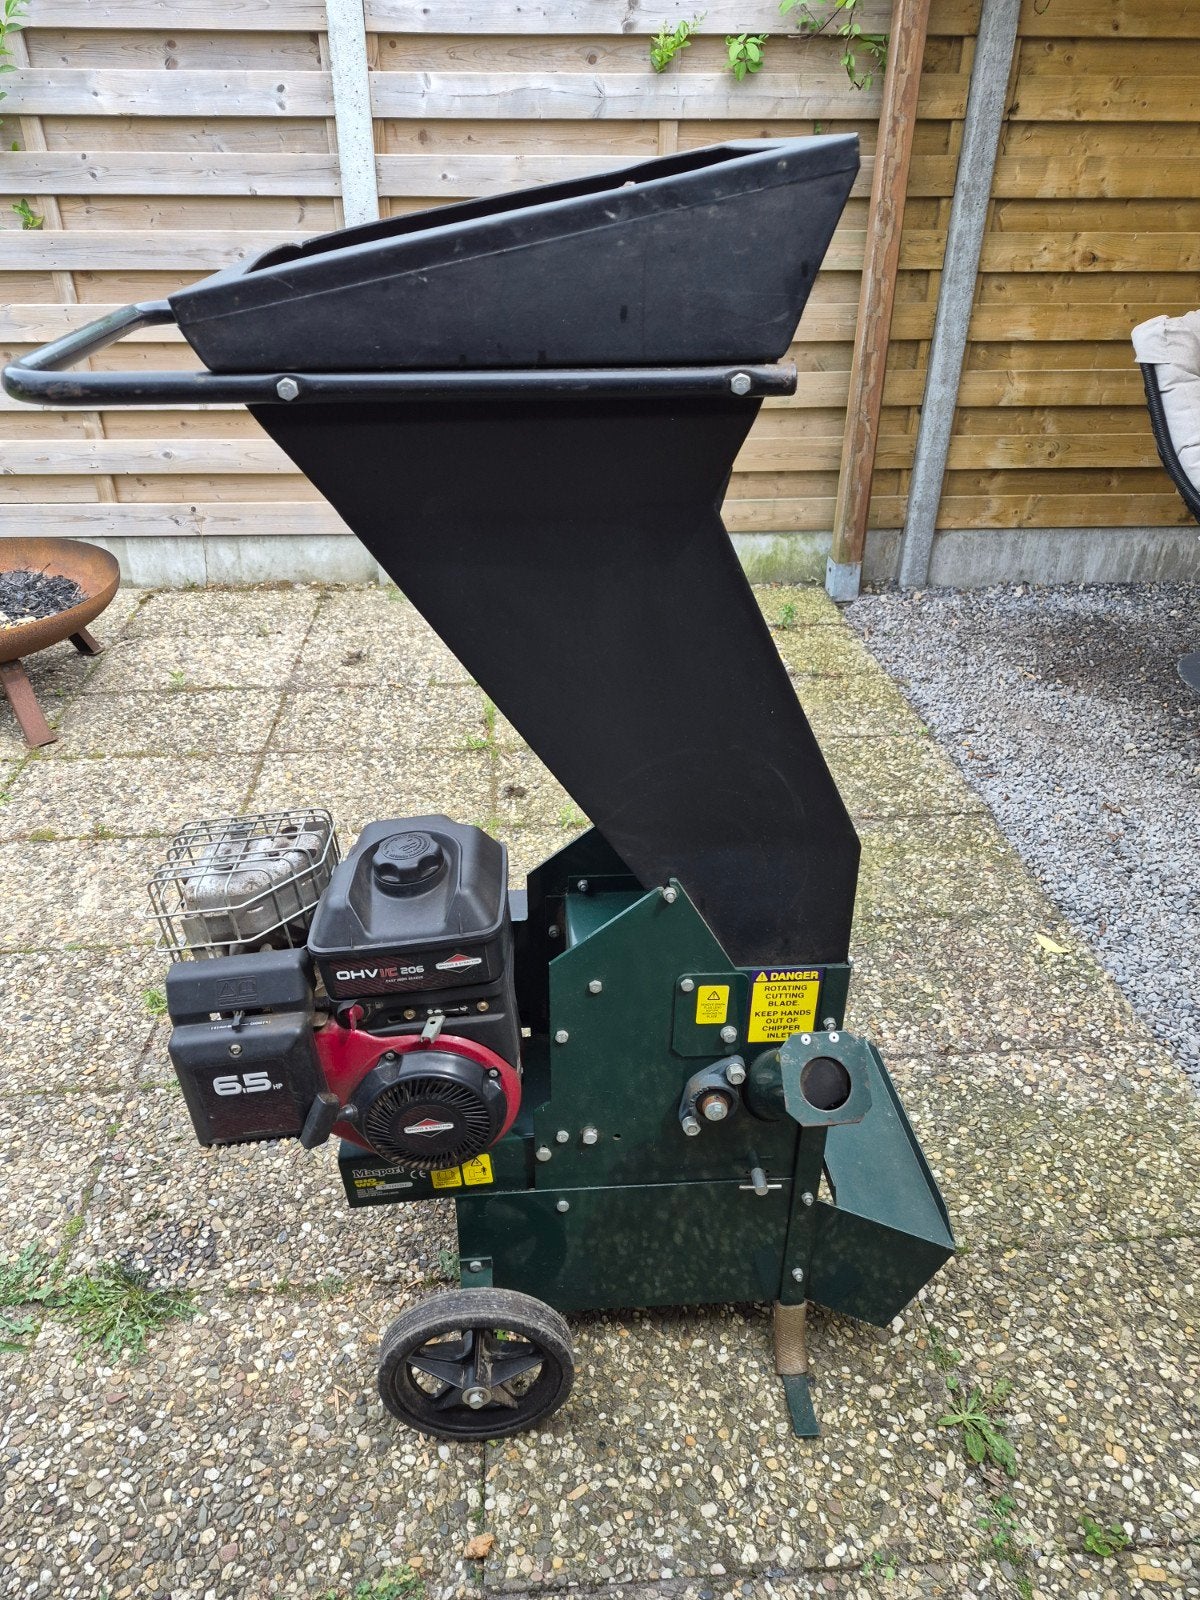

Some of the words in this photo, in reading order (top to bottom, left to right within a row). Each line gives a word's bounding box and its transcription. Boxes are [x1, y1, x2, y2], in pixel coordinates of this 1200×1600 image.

[336, 968, 378, 981] OHV
[400, 965, 424, 975] 206
[770, 970, 819, 981] DANGER
[213, 1071, 272, 1096] 6.5
[352, 1166, 405, 1179] Masport
